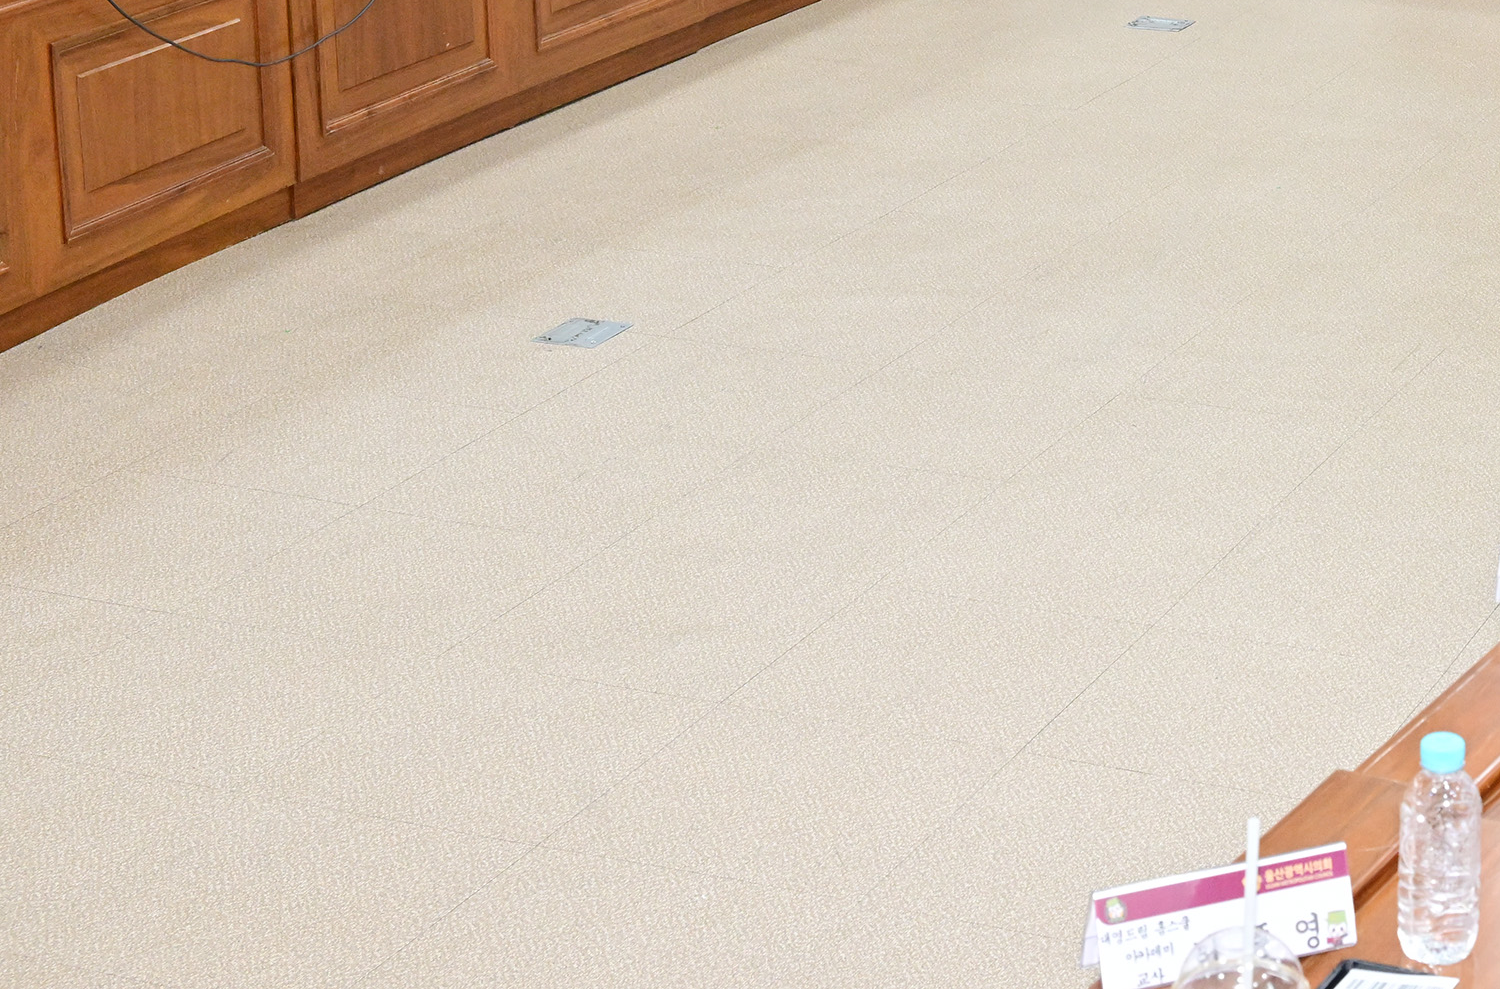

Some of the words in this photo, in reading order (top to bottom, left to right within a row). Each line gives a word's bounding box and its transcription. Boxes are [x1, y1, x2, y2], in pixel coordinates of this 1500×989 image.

[1264, 856, 1333, 884] 울산광역시의회
[1154, 915, 1190, 936] 홈스쿨
[1125, 941, 1175, 963] 아카데미
